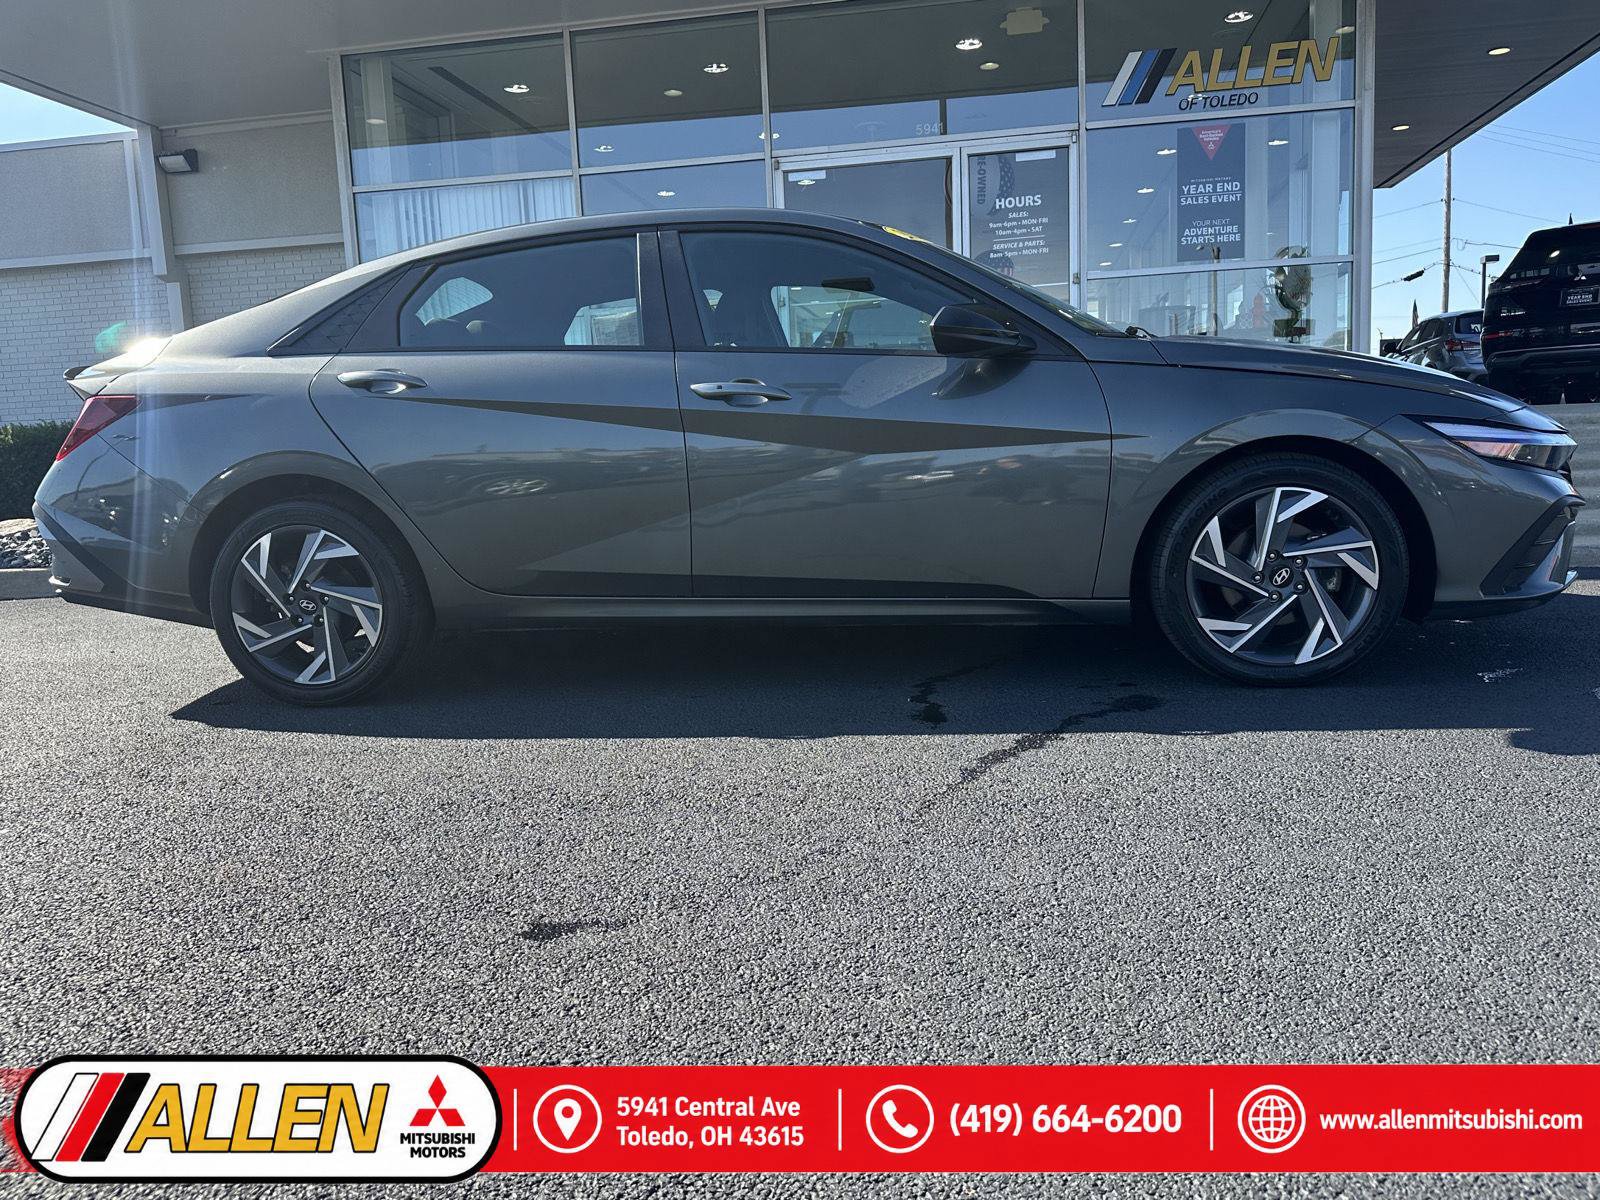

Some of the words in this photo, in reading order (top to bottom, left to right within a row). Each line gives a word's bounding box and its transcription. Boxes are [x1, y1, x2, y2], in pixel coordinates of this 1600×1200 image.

[1165, 37, 1339, 96] ALLEN
[1178, 95, 1200, 110] OF
[1200, 92, 1259, 109] TOLEDO
[915, 121, 944, 135] 5941
[1182, 184, 1213, 195] YEAR
[1216, 181, 1240, 192] END
[995, 194, 1042, 210] HOURS
[1180, 195, 1209, 206] SALES
[1211, 193, 1241, 203] EVENT
[1008, 211, 1029, 219] SALES:
[989, 220, 1018, 229] 9am-6pm
[1021, 217, 1049, 225] MON-FRI
[1192, 219, 1210, 227] YOUR
[1212, 218, 1230, 226] NEXT
[995, 227, 1027, 236] 10am-4pm
[1031, 225, 1043, 233] SAT
[1184, 225, 1239, 236] ADVENTURE
[993, 241, 1017, 250] SERVICE
[1024, 239, 1046, 248] PARTS:
[1180, 235, 1215, 245] STARTS
[1217, 233, 1241, 243] HERE
[989, 249, 1018, 258] 8am-5pm
[1022, 247, 1049, 256] MON-FRI
